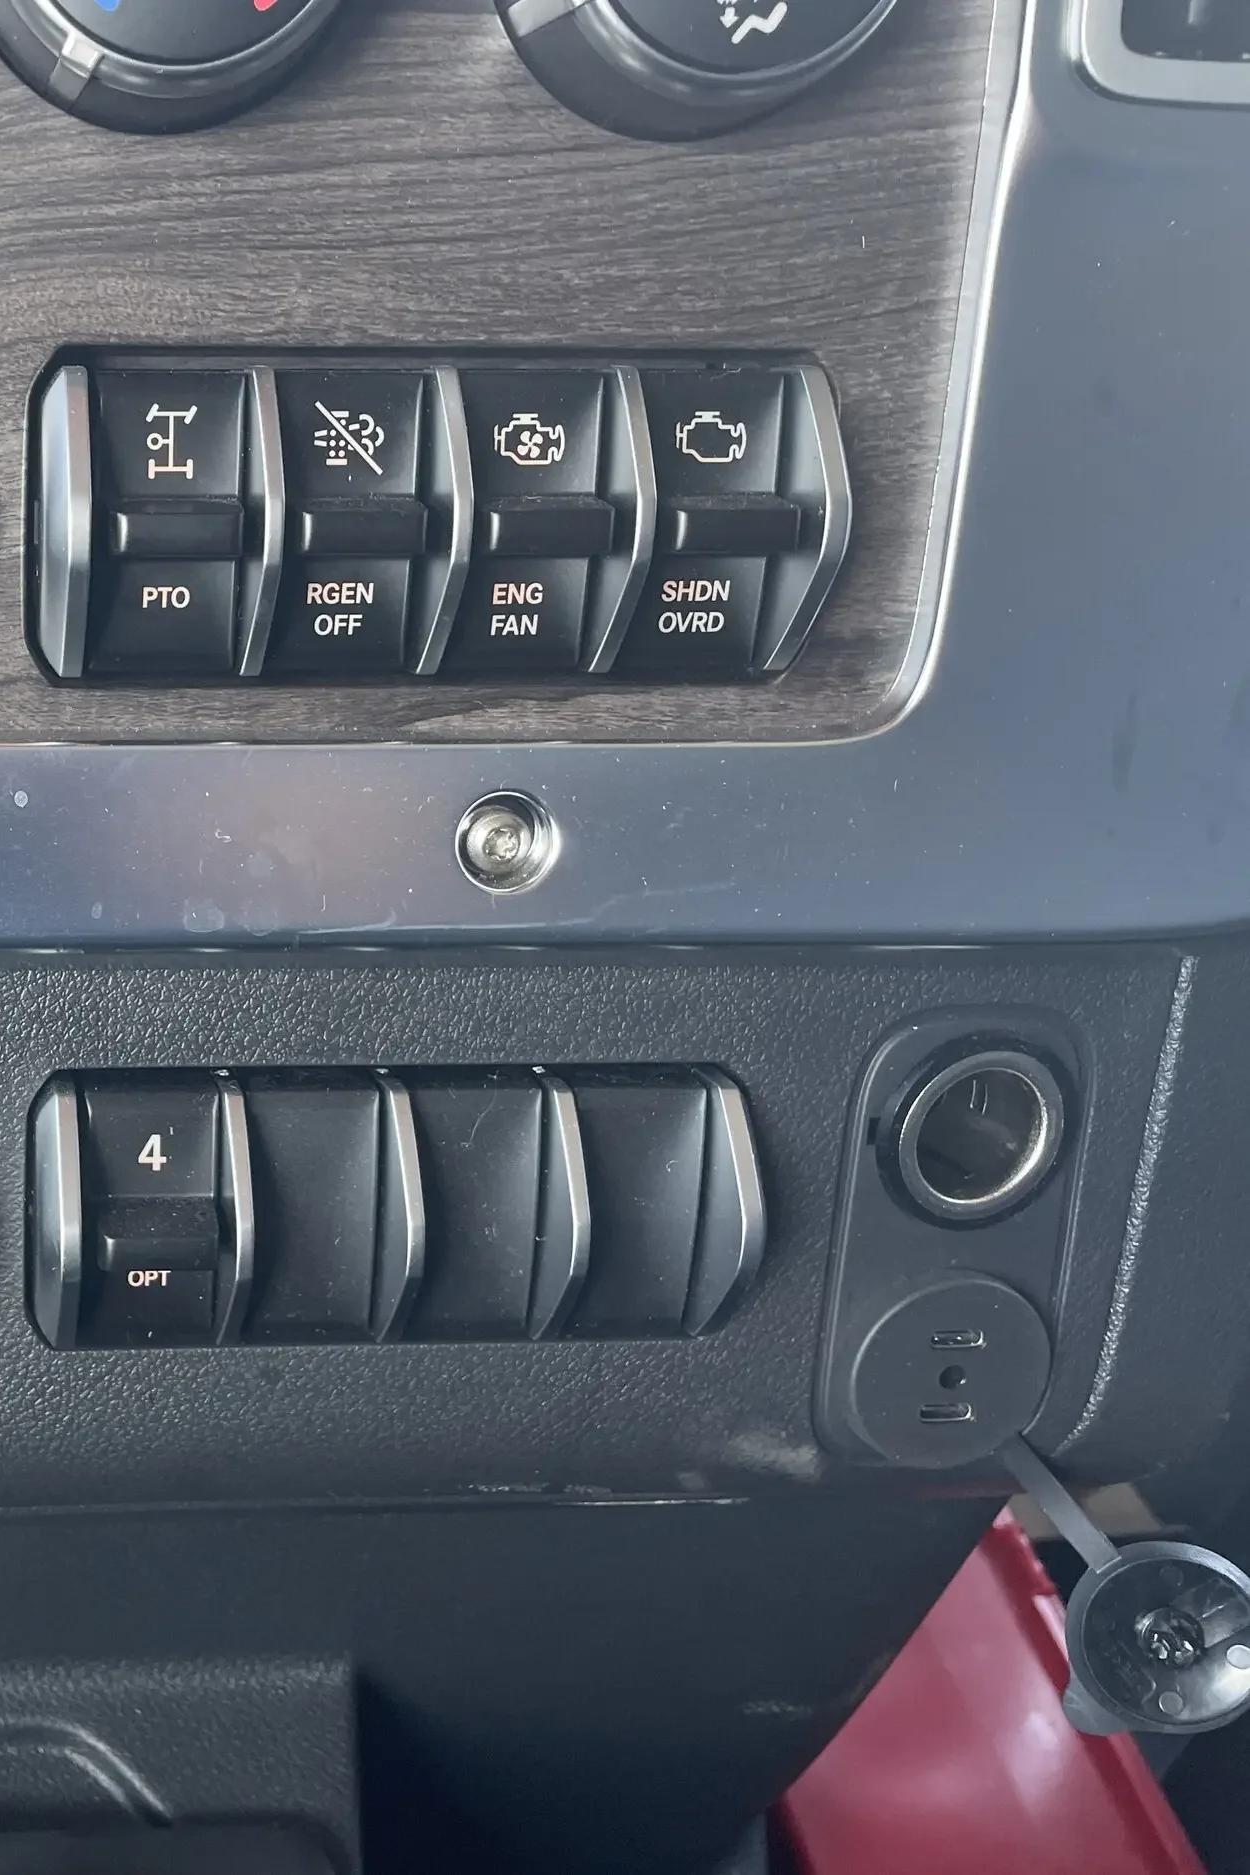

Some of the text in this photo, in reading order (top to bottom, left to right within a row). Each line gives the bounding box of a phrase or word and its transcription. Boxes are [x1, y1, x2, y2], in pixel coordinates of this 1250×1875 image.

[142, 586, 191, 609] PTO
[307, 582, 374, 605] RGEN
[492, 582, 544, 605] ENG
[661, 580, 731, 602] SHDN
[314, 614, 363, 636] OFF
[490, 614, 539, 636] FAN
[658, 611, 725, 633] OVRD
[137, 1134, 167, 1171] 4
[127, 1270, 172, 1287] OPT
